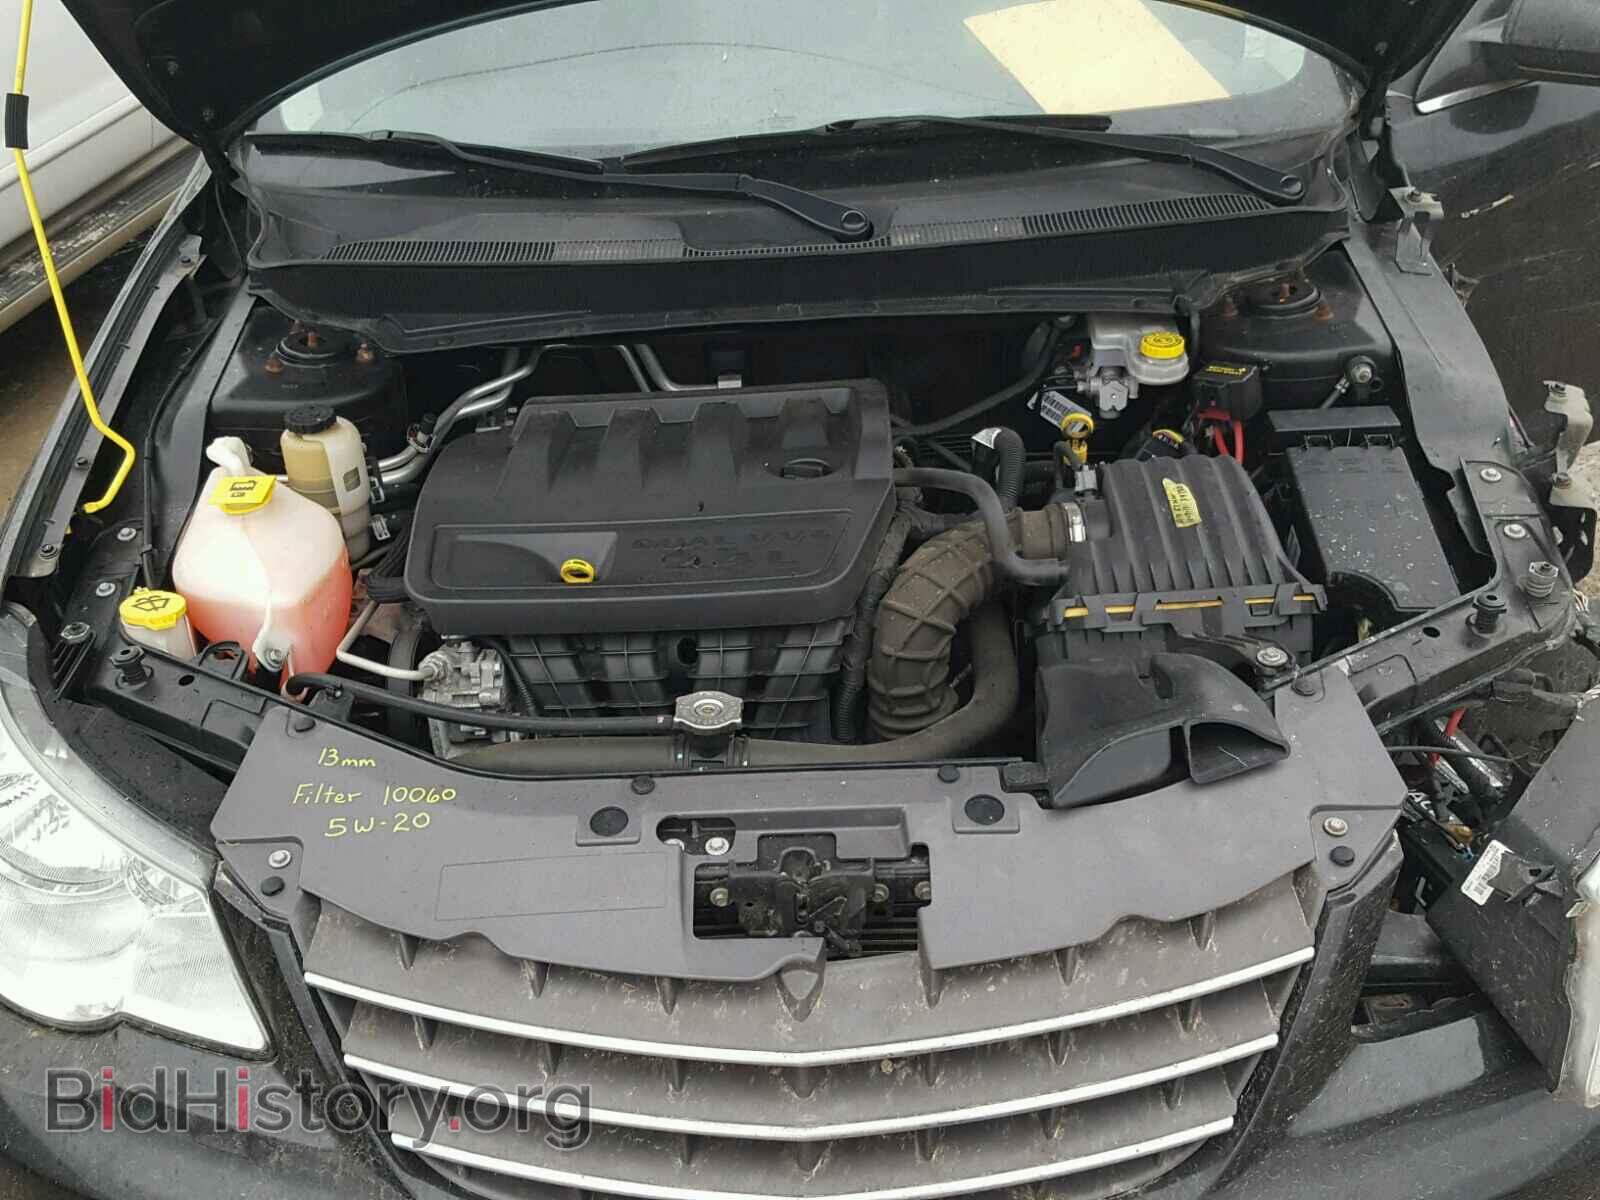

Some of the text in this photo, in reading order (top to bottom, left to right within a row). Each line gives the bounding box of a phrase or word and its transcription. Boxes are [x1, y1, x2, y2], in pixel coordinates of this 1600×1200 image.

[317, 747, 377, 768] 13mm
[292, 782, 457, 806] Filter 10060
